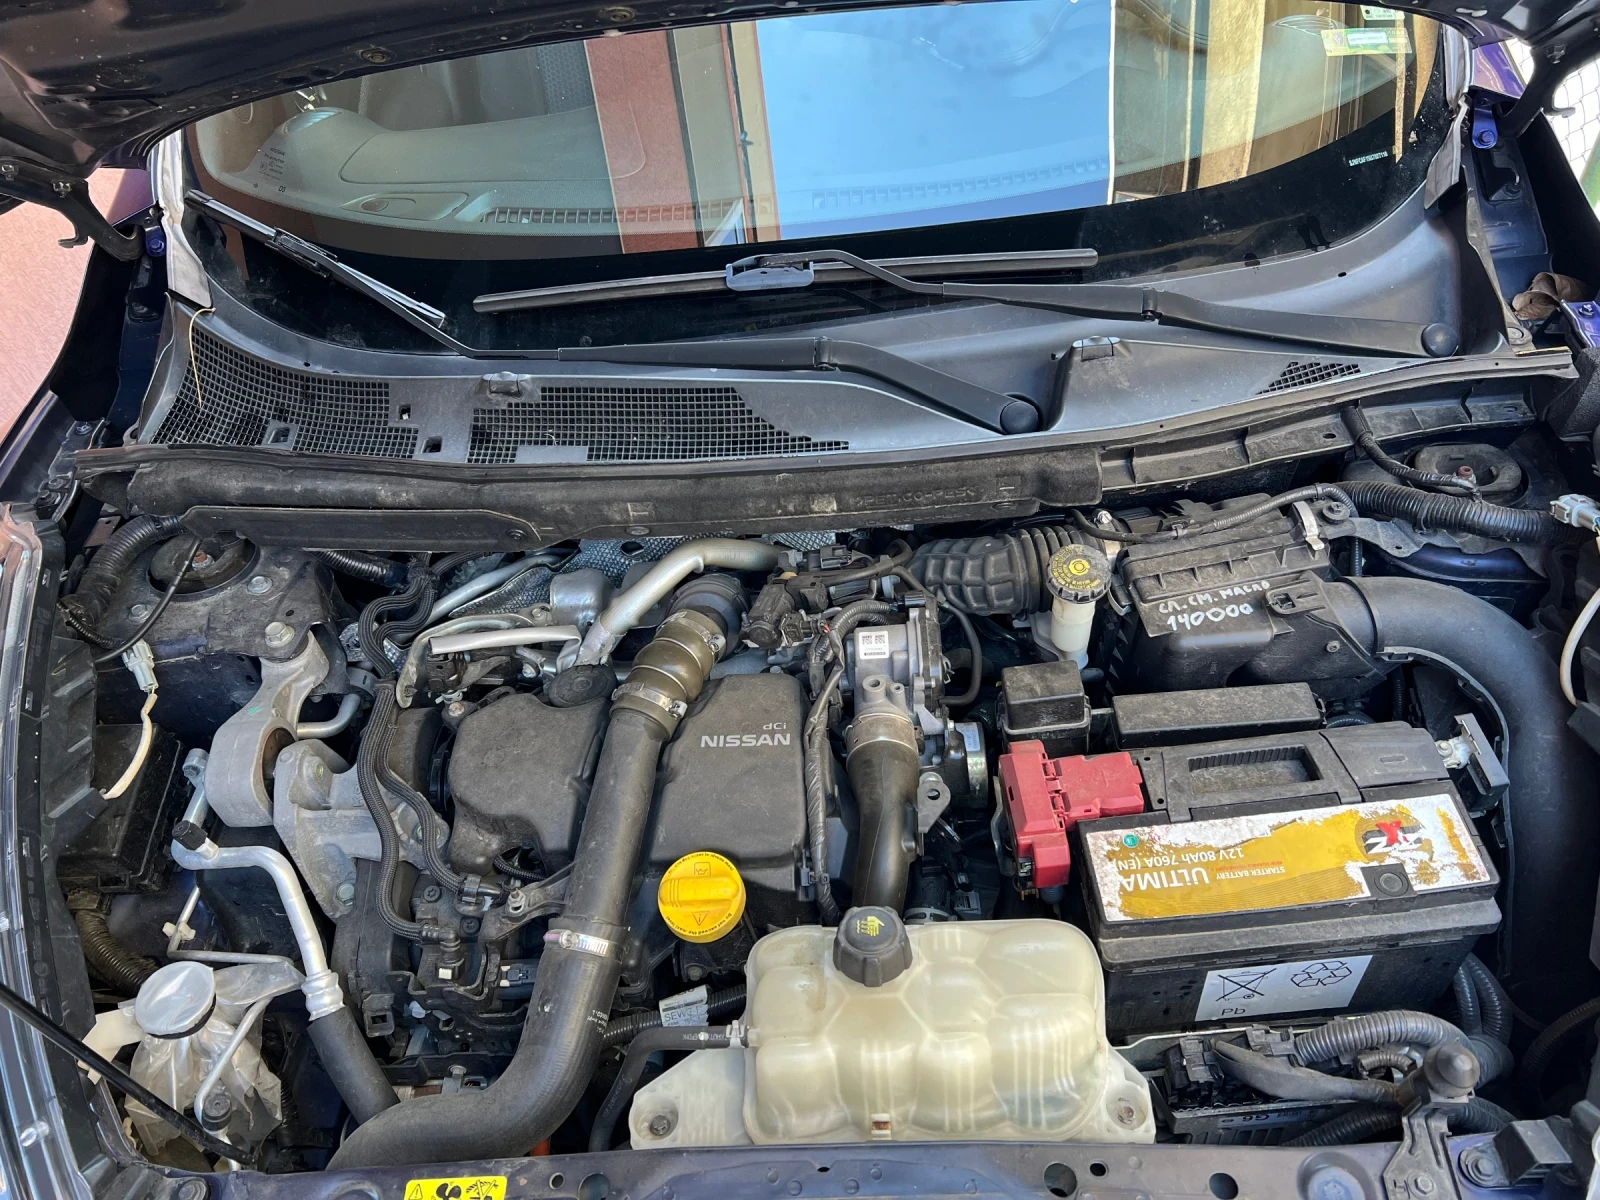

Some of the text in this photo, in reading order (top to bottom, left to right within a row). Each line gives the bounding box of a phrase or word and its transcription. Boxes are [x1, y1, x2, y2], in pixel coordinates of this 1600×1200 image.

[1167, 603, 1253, 630] 140000
[700, 734, 790, 748] NISSAN
[1181, 850, 1216, 864] 80Ah
[1220, 848, 1244, 860] 12V
[1144, 855, 1179, 868] 760A
[1120, 868, 1210, 892] ULTIMA
[1216, 866, 1286, 880] STARTER BATTERY
[1221, 1008, 1246, 1016] Pb
